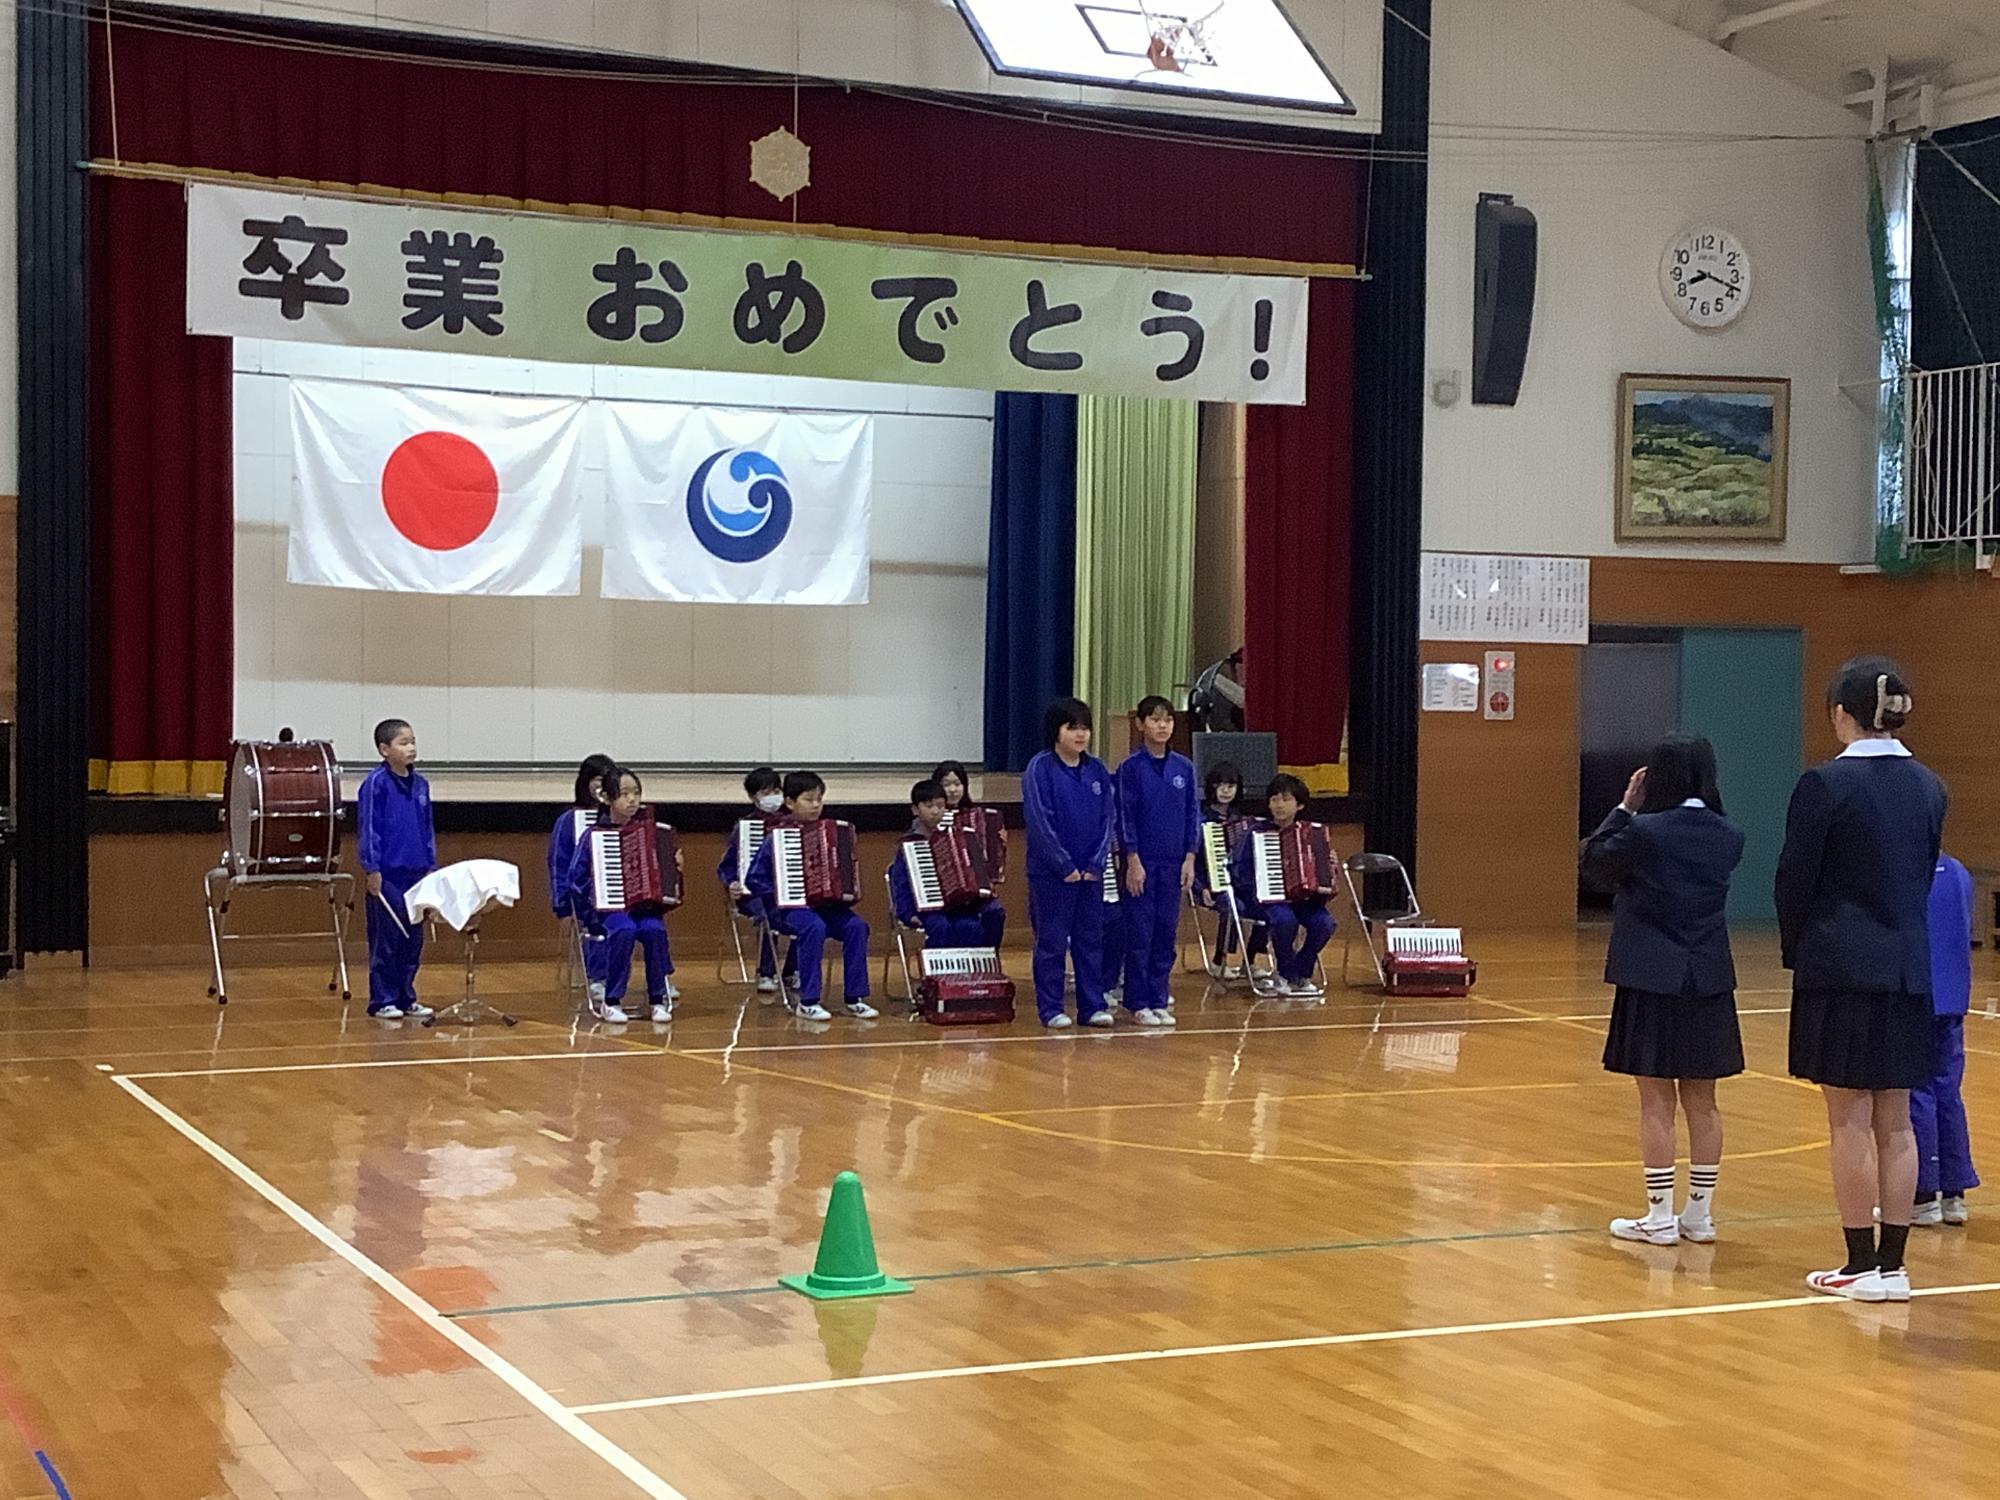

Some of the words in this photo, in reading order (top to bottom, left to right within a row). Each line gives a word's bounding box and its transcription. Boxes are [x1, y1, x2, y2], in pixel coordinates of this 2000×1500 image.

[1702, 235, 1714, 250] 12
[1674, 249, 1690, 264] 10
[1727, 252, 1736, 266] 2
[1672, 266, 1682, 281] 9
[1730, 269, 1740, 284] 3
[1677, 282, 1687, 297] 8
[1725, 287, 1735, 299] 4
[1689, 297, 1697, 310] 7
[1700, 301, 1710, 316] 6
[1714, 297, 1723, 312] 5
